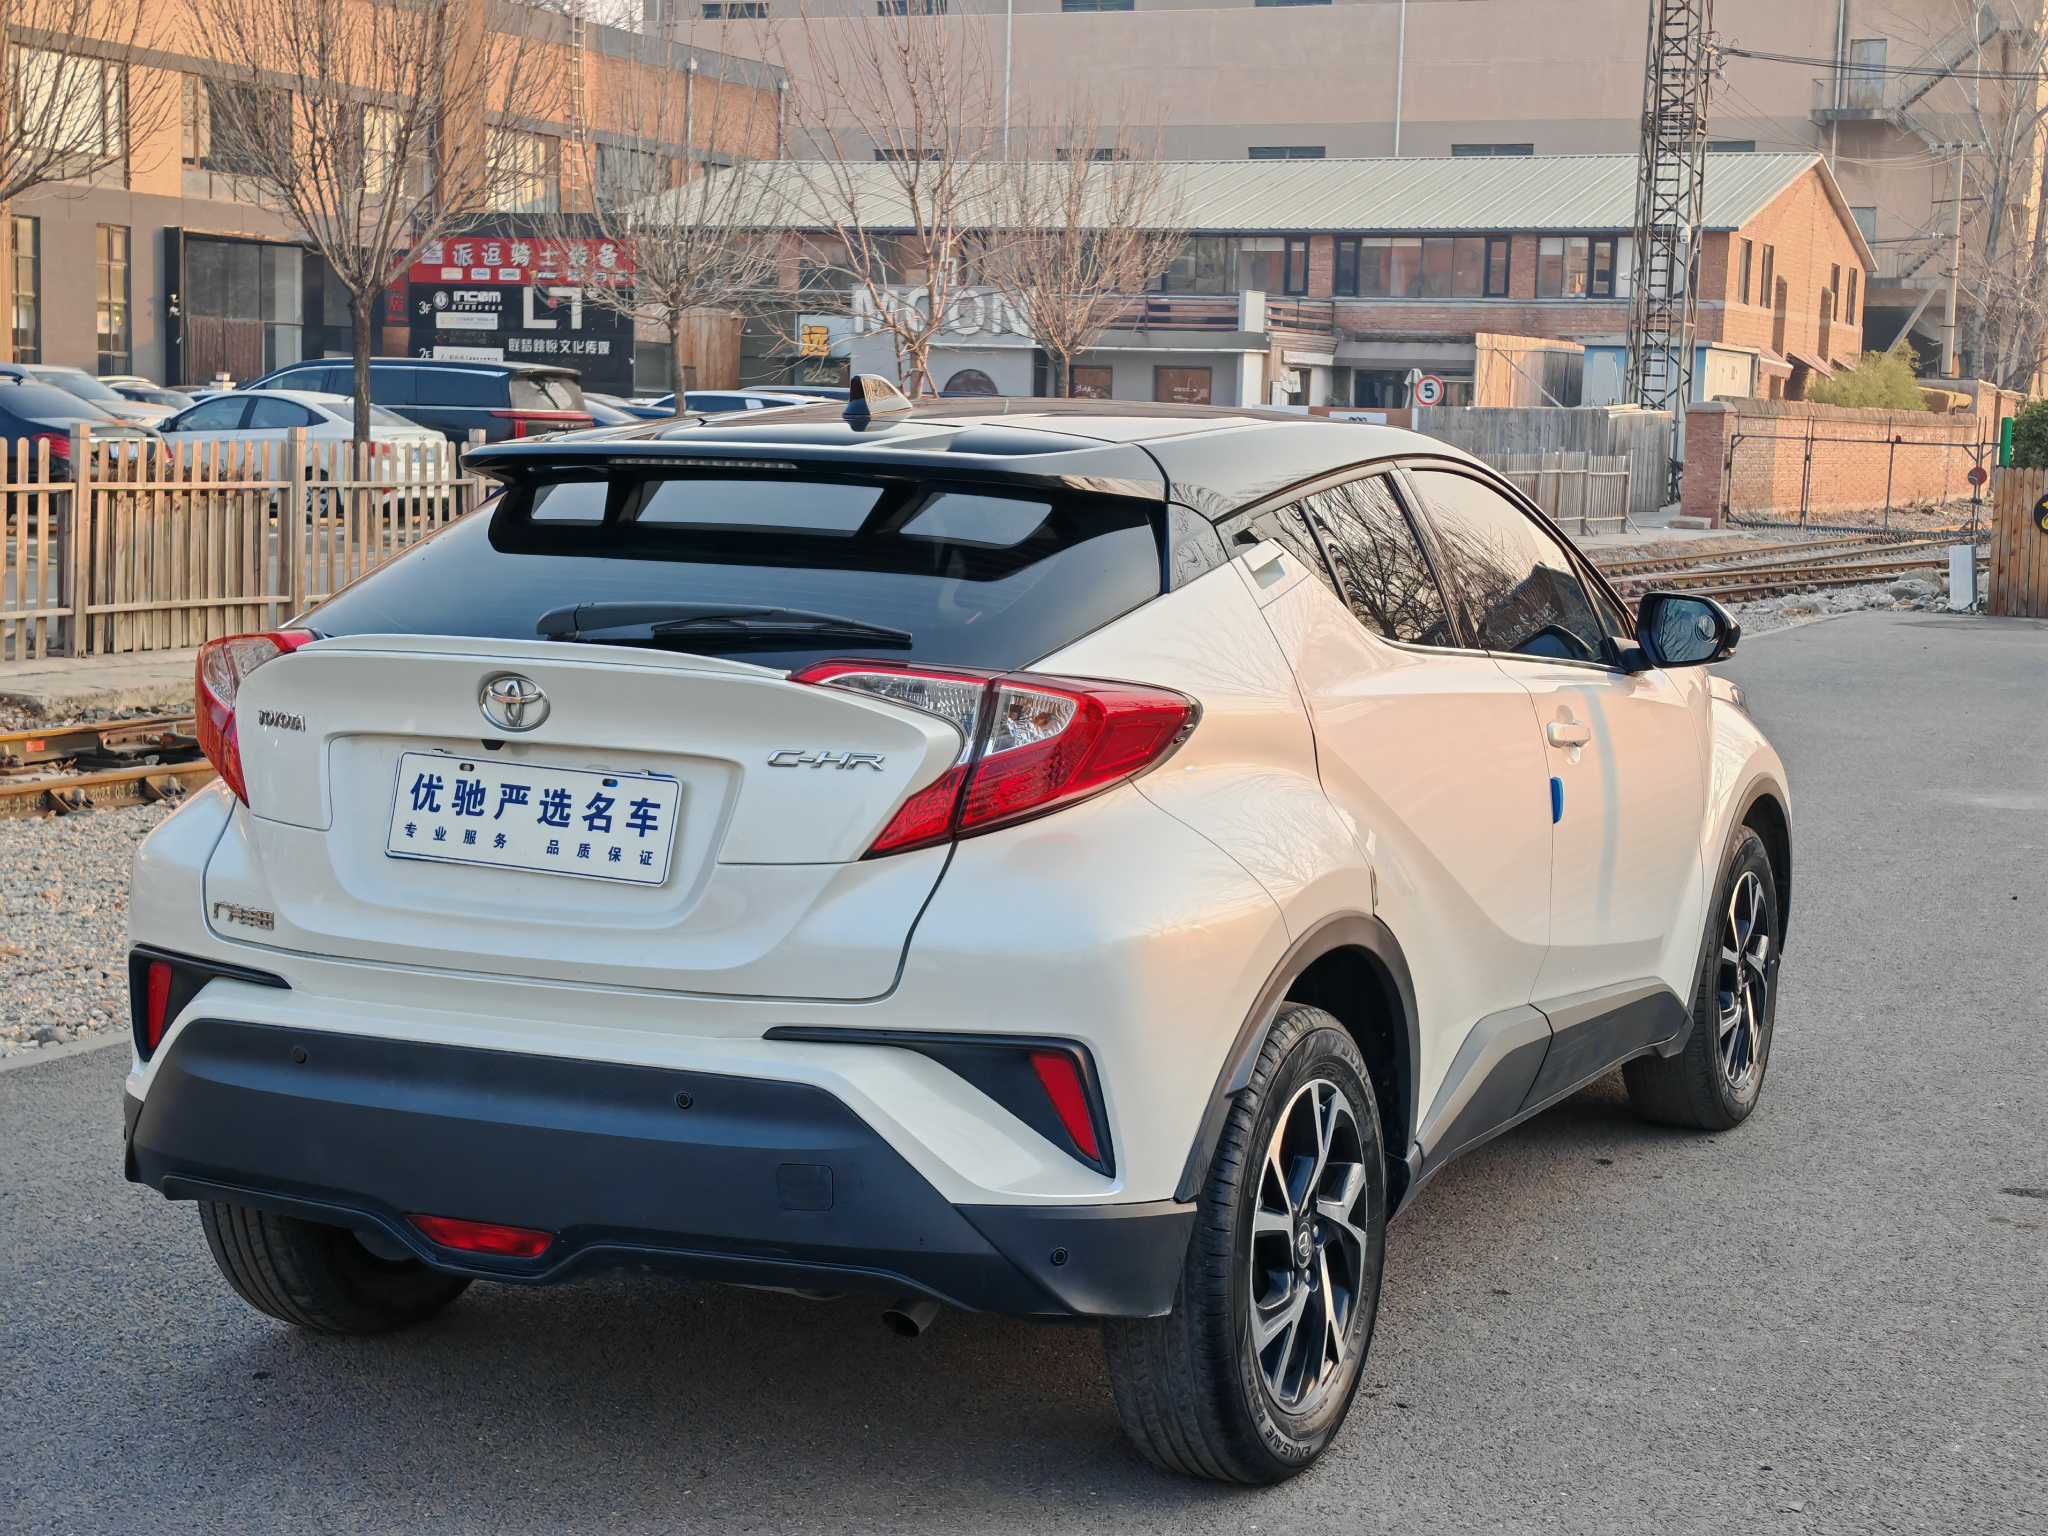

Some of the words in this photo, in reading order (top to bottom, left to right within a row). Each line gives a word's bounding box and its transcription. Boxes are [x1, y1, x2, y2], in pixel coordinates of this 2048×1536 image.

[418, 301, 432, 314] 3F
[1424, 382, 1435, 399] 5
[258, 710, 306, 733] TOYOTA
[767, 749, 886, 772] C-HR
[410, 772, 661, 838] 优驰严选名车
[404, 821, 507, 849] 专业服务
[546, 839, 654, 866] 品质保证
